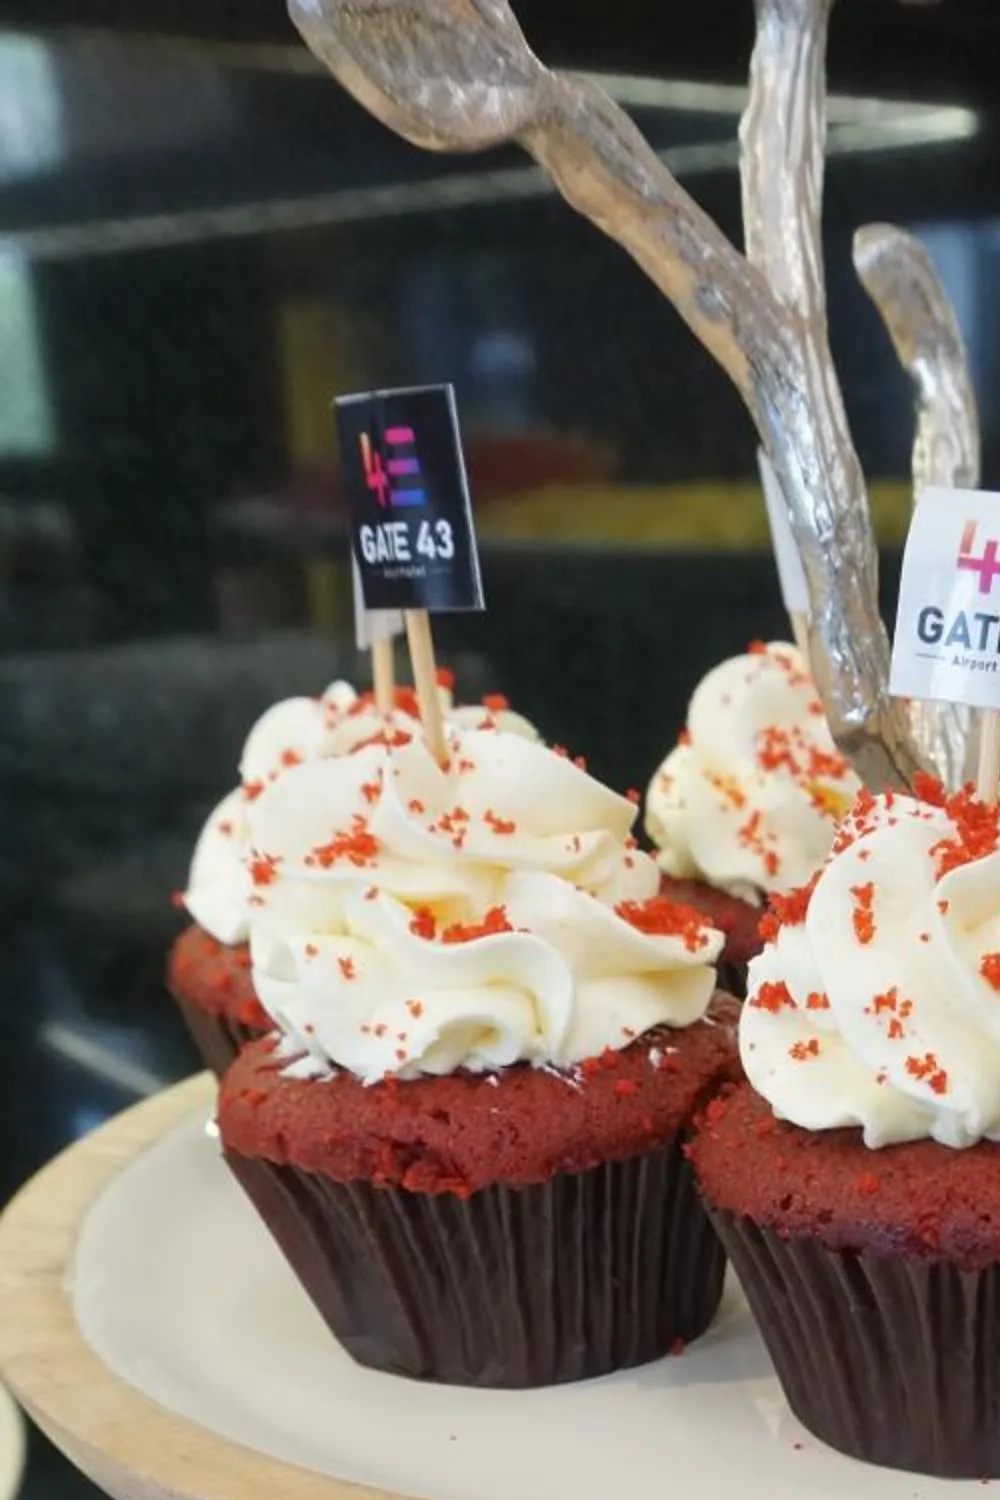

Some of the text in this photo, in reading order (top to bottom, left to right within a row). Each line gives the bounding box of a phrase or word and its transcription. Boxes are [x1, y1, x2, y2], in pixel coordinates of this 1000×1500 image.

[359, 518, 455, 565] GATE 43
[952, 654, 998, 673] Airport
